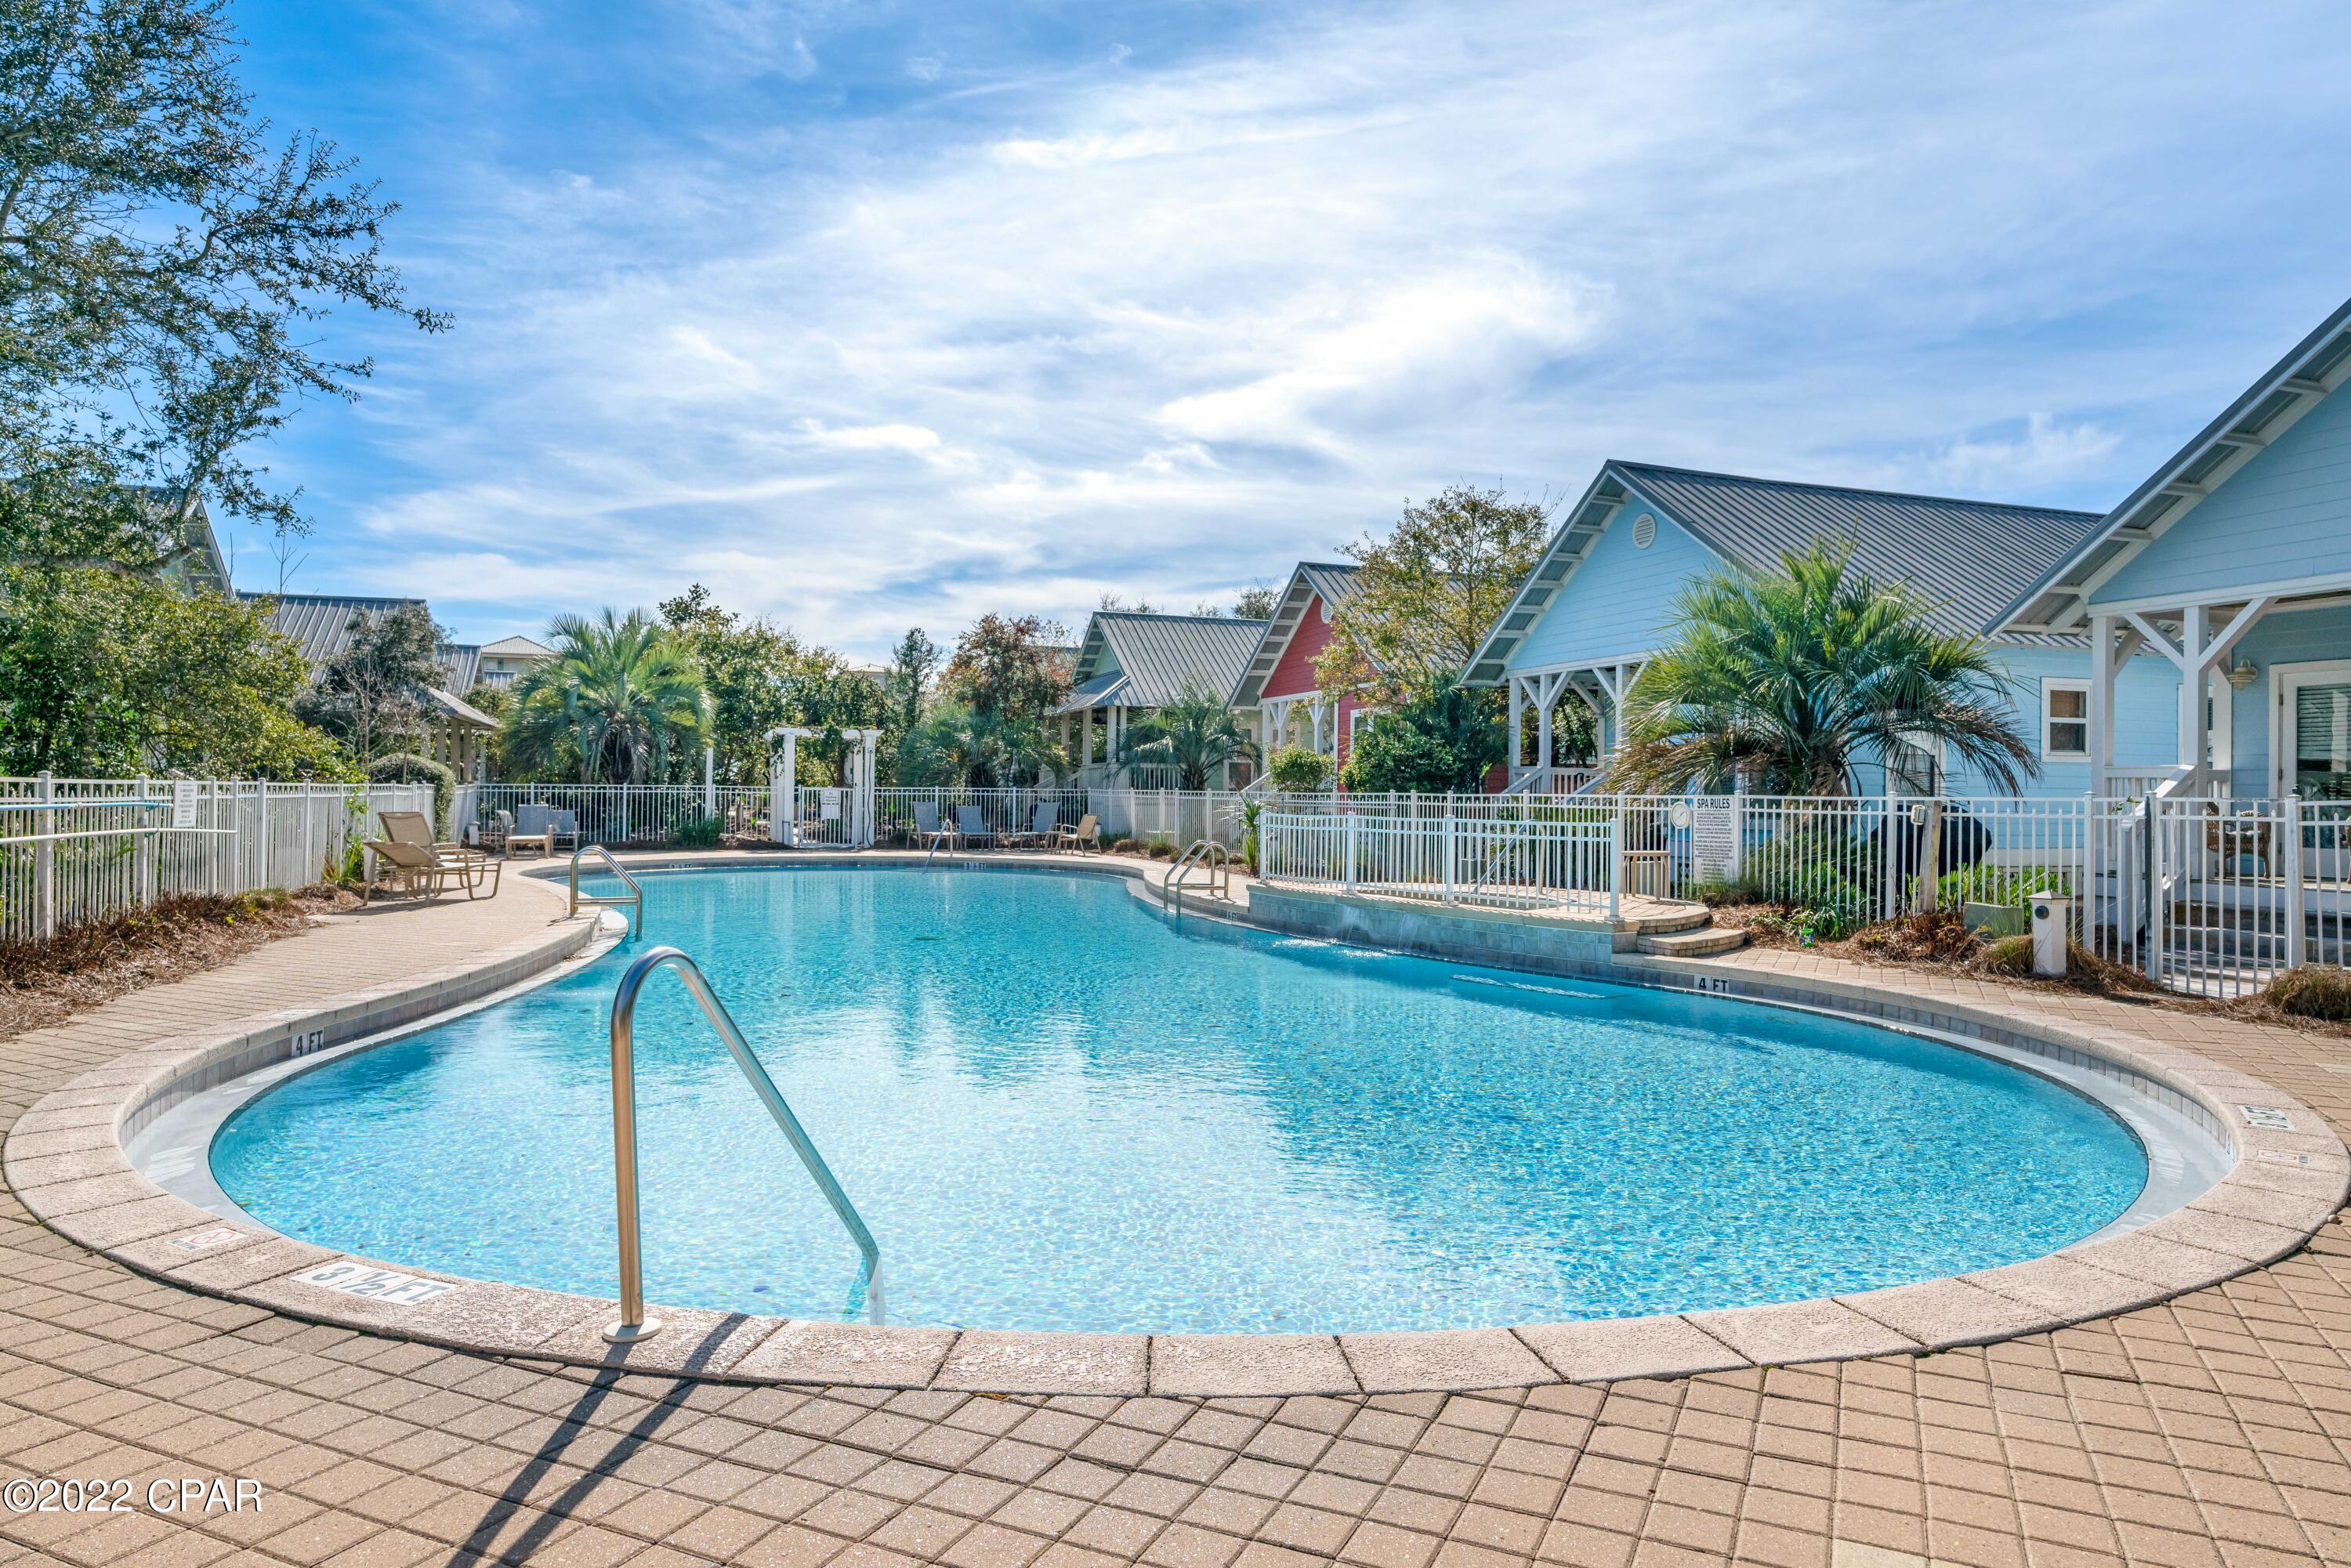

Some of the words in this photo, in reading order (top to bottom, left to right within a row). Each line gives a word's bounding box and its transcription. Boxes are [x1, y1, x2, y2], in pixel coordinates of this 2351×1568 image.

[1697, 798, 1709, 809] SPA
[1710, 798, 1730, 809] RULES
[1698, 977, 1706, 990] 4
[1713, 979, 1728, 992] FT
[296, 1034, 303, 1056] 4
[312, 1266, 355, 1281] 3
